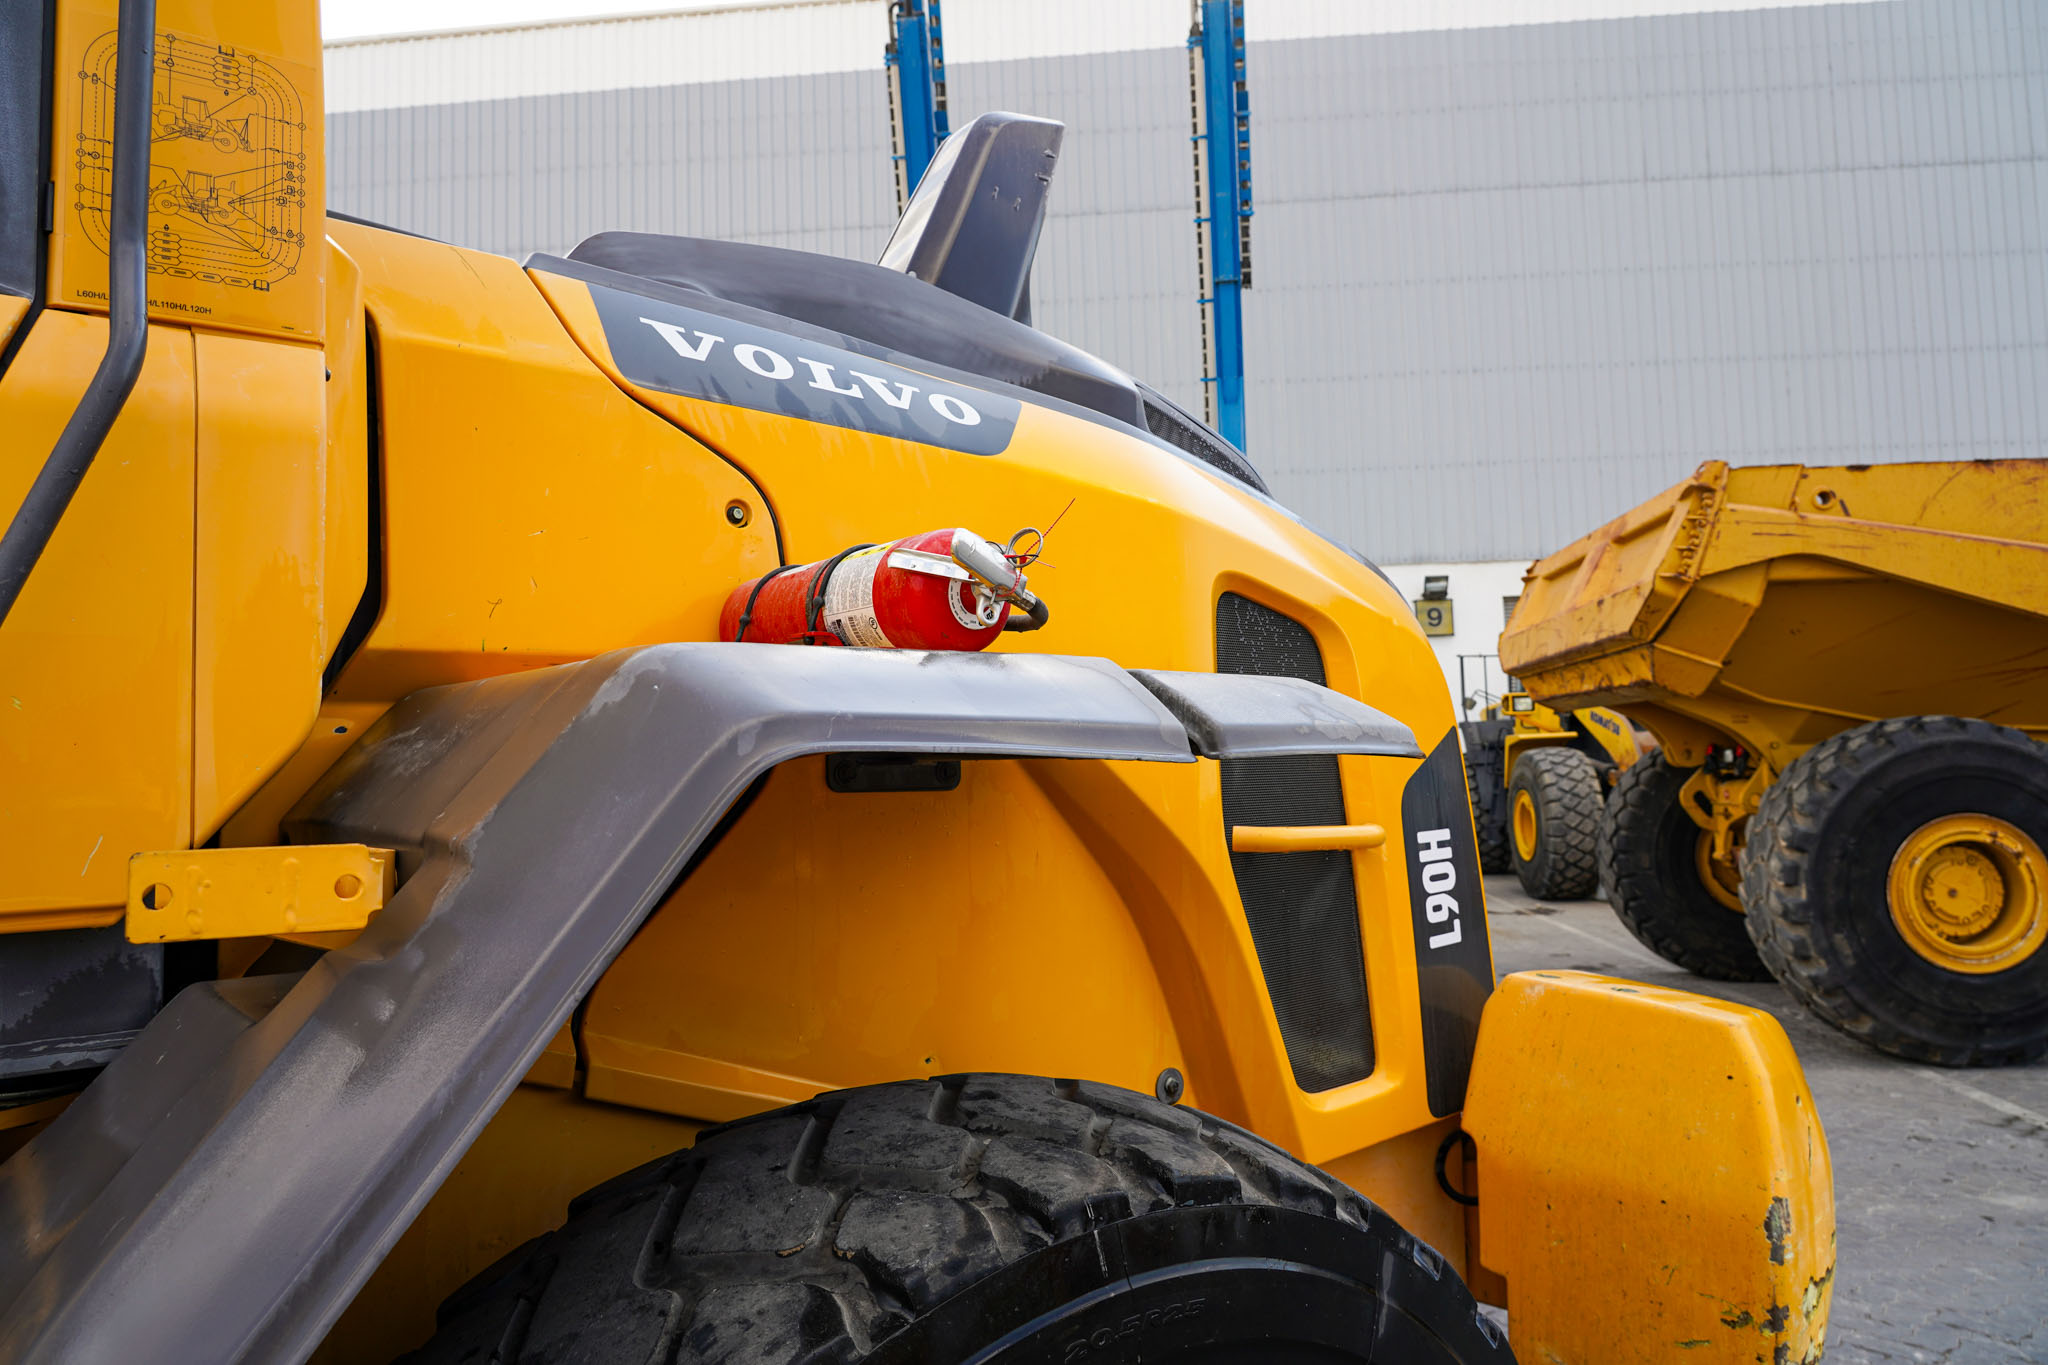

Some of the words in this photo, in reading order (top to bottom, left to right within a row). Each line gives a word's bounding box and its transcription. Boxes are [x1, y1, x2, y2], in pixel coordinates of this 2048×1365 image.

[639, 317, 982, 426] VOLVO
[1427, 607, 1442, 627] 9
[1416, 828, 1462, 949] L90H
